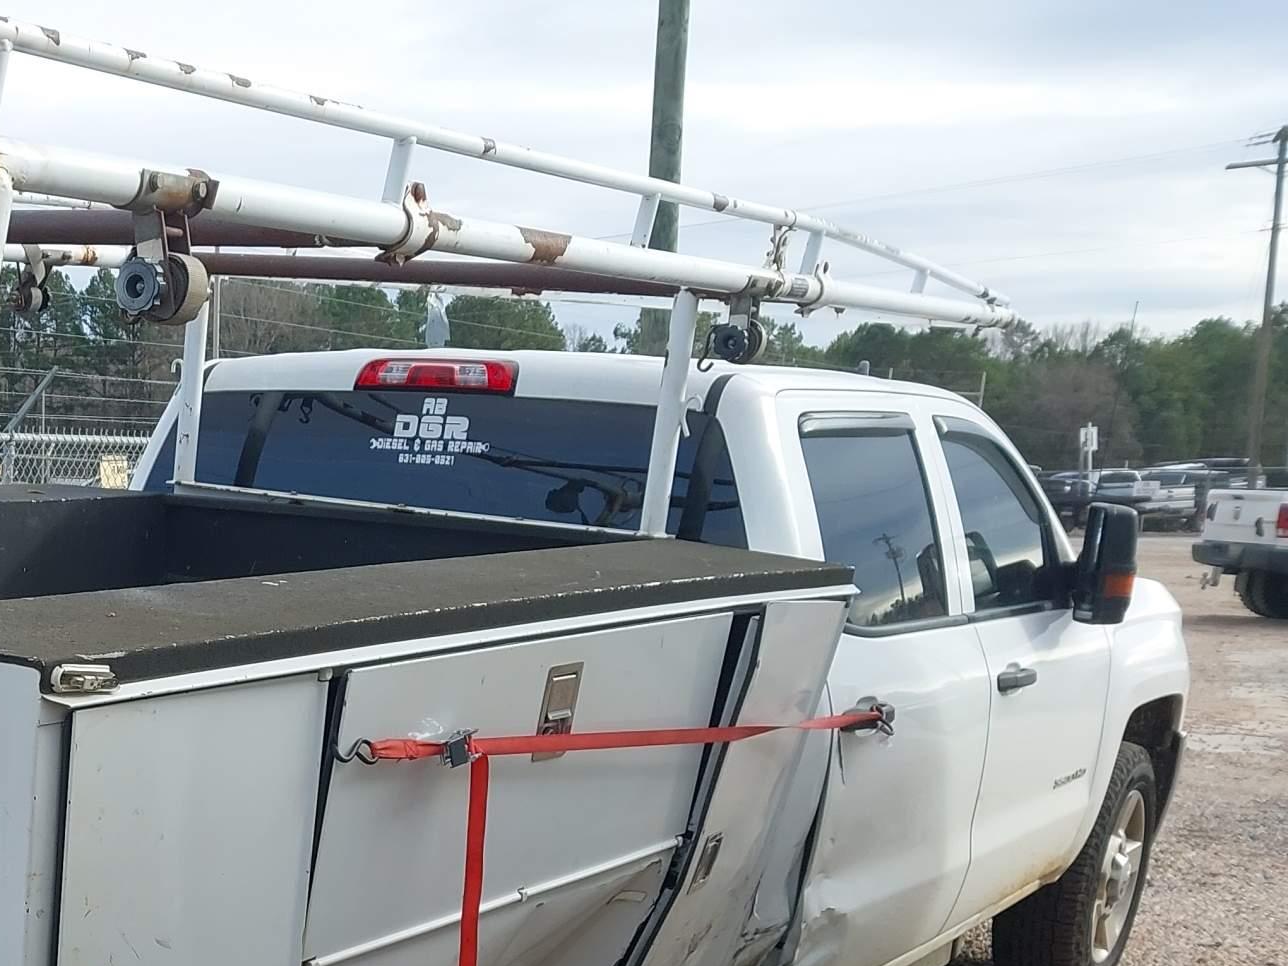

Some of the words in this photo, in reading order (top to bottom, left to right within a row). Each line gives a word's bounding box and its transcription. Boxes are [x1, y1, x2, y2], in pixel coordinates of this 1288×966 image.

[422, 397, 448, 415] AB
[394, 414, 469, 439] DGR
[424, 440, 444, 452] GAS
